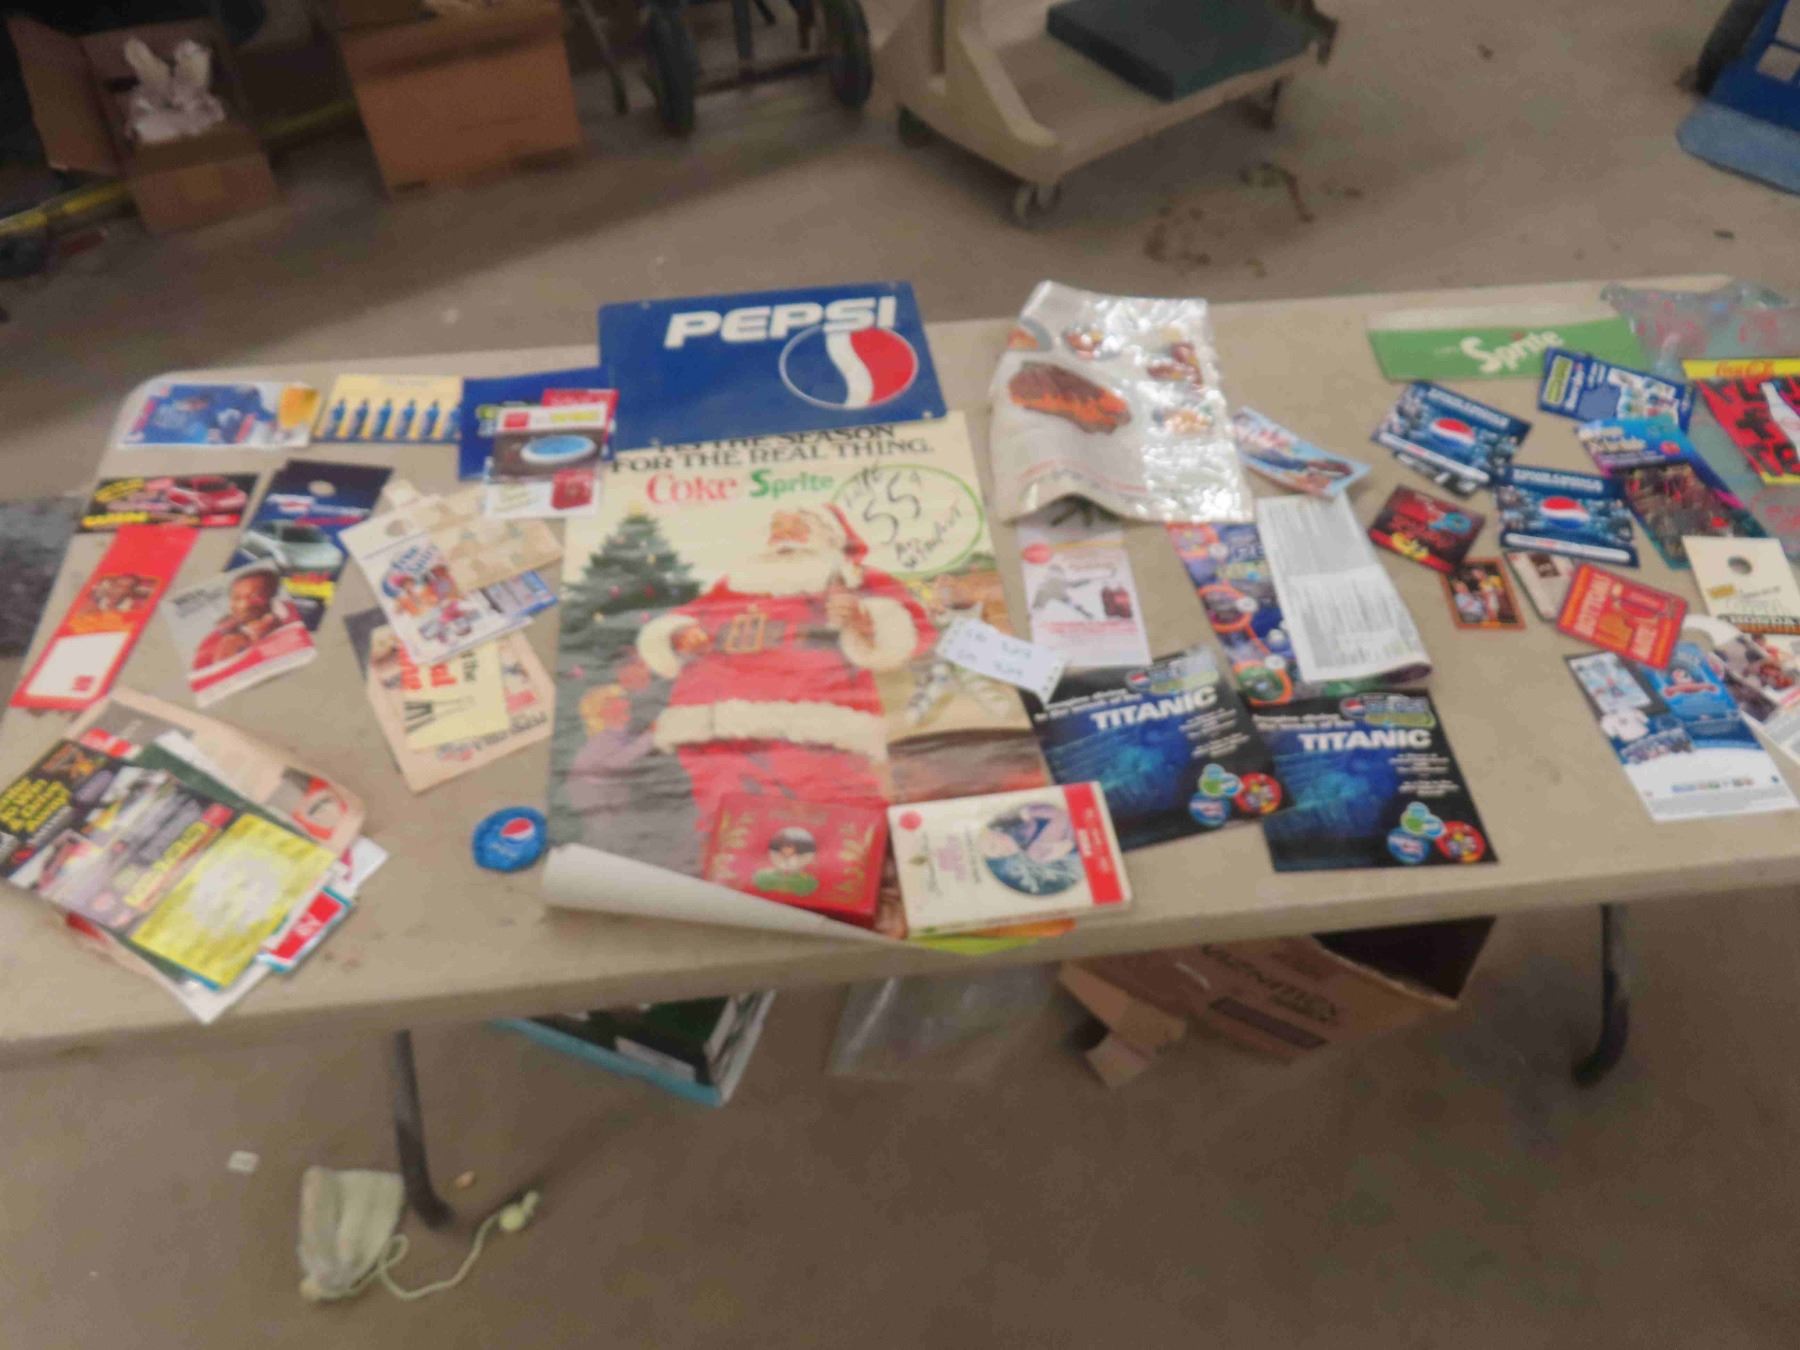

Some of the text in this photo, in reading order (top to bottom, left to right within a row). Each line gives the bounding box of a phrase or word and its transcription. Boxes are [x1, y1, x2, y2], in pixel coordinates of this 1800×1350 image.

[664, 296, 897, 349] PEPSI
[1460, 331, 1564, 372] Sprite
[612, 438, 936, 473] FOR THE REAL THING.
[645, 471, 737, 503] Coke
[750, 469, 834, 499] Sprite
[1090, 686, 1218, 730] TITANIC
[1298, 729, 1431, 751] TITANIC
